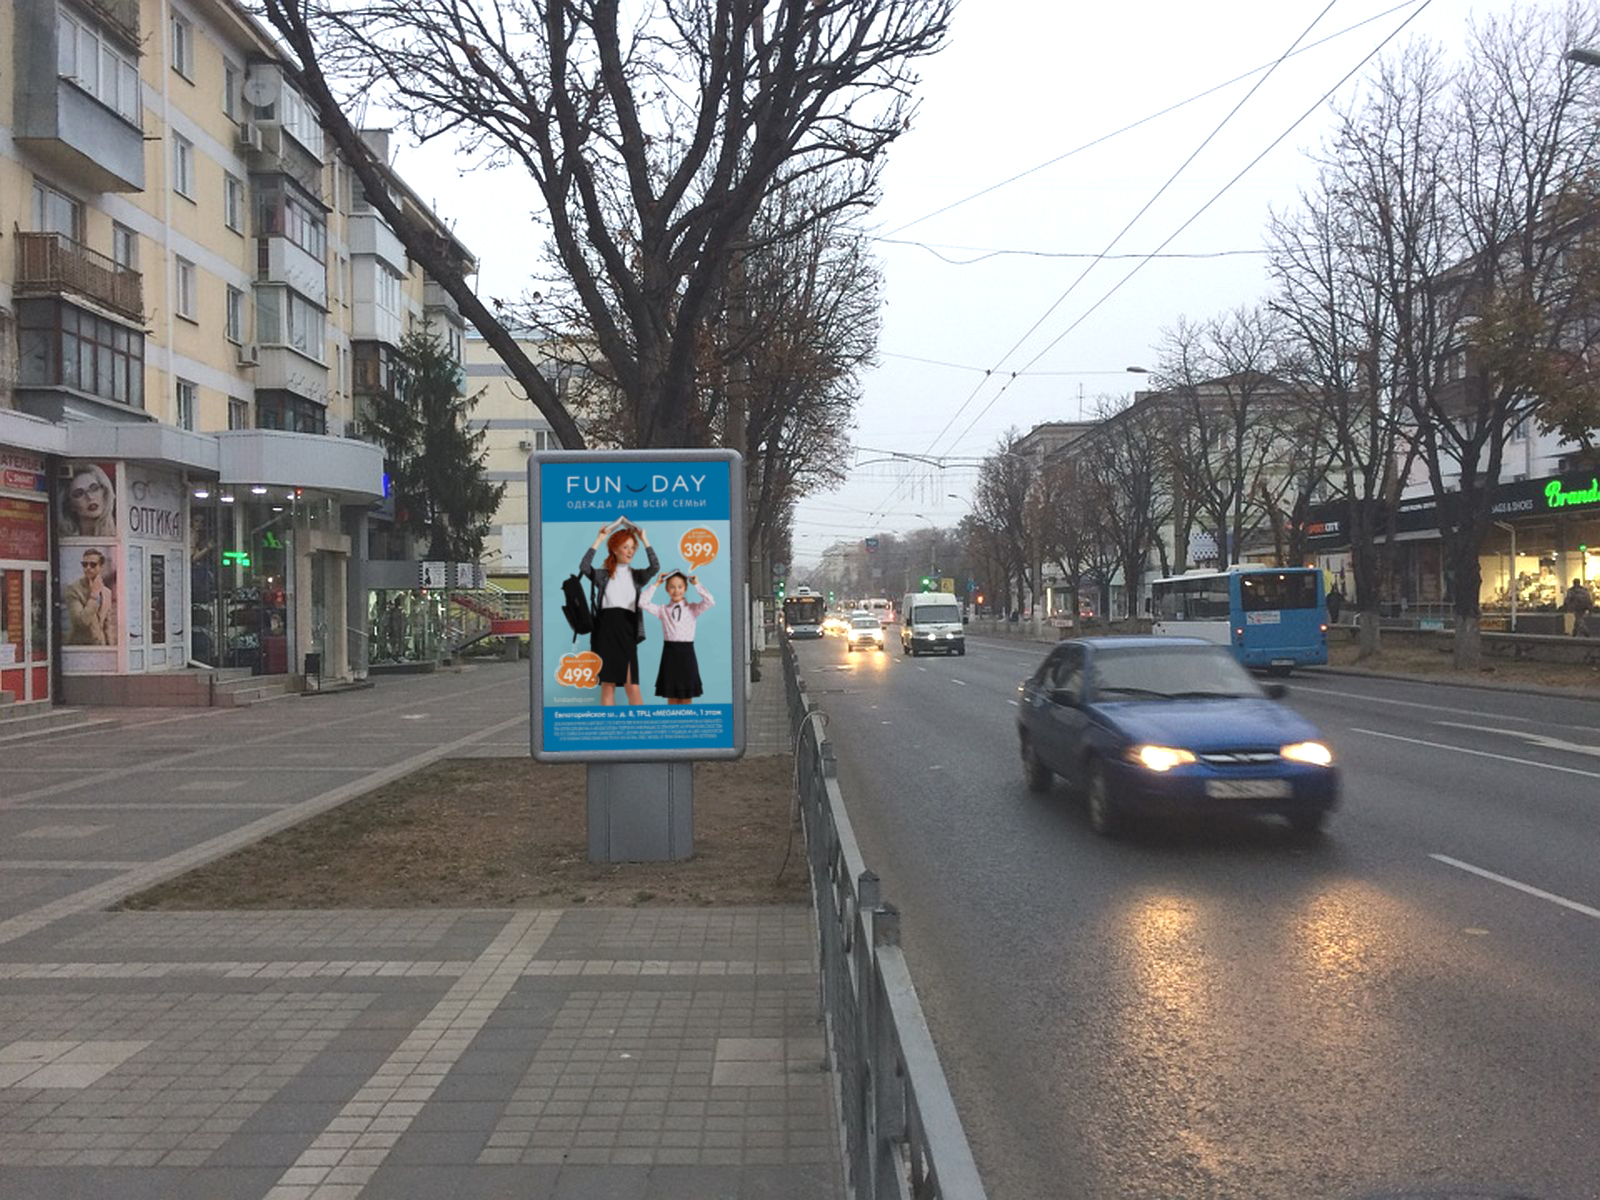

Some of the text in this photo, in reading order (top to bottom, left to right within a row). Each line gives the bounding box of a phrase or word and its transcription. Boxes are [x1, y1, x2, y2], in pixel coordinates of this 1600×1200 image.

[567, 474, 706, 494] FUN DAY
[567, 498, 706, 510] ОДЕЖДА ДЛЯ ВСЕЙ СЕМЬИ
[129, 506, 182, 537] ОПТИКА
[554, 711, 606, 719] Евпаторийское
